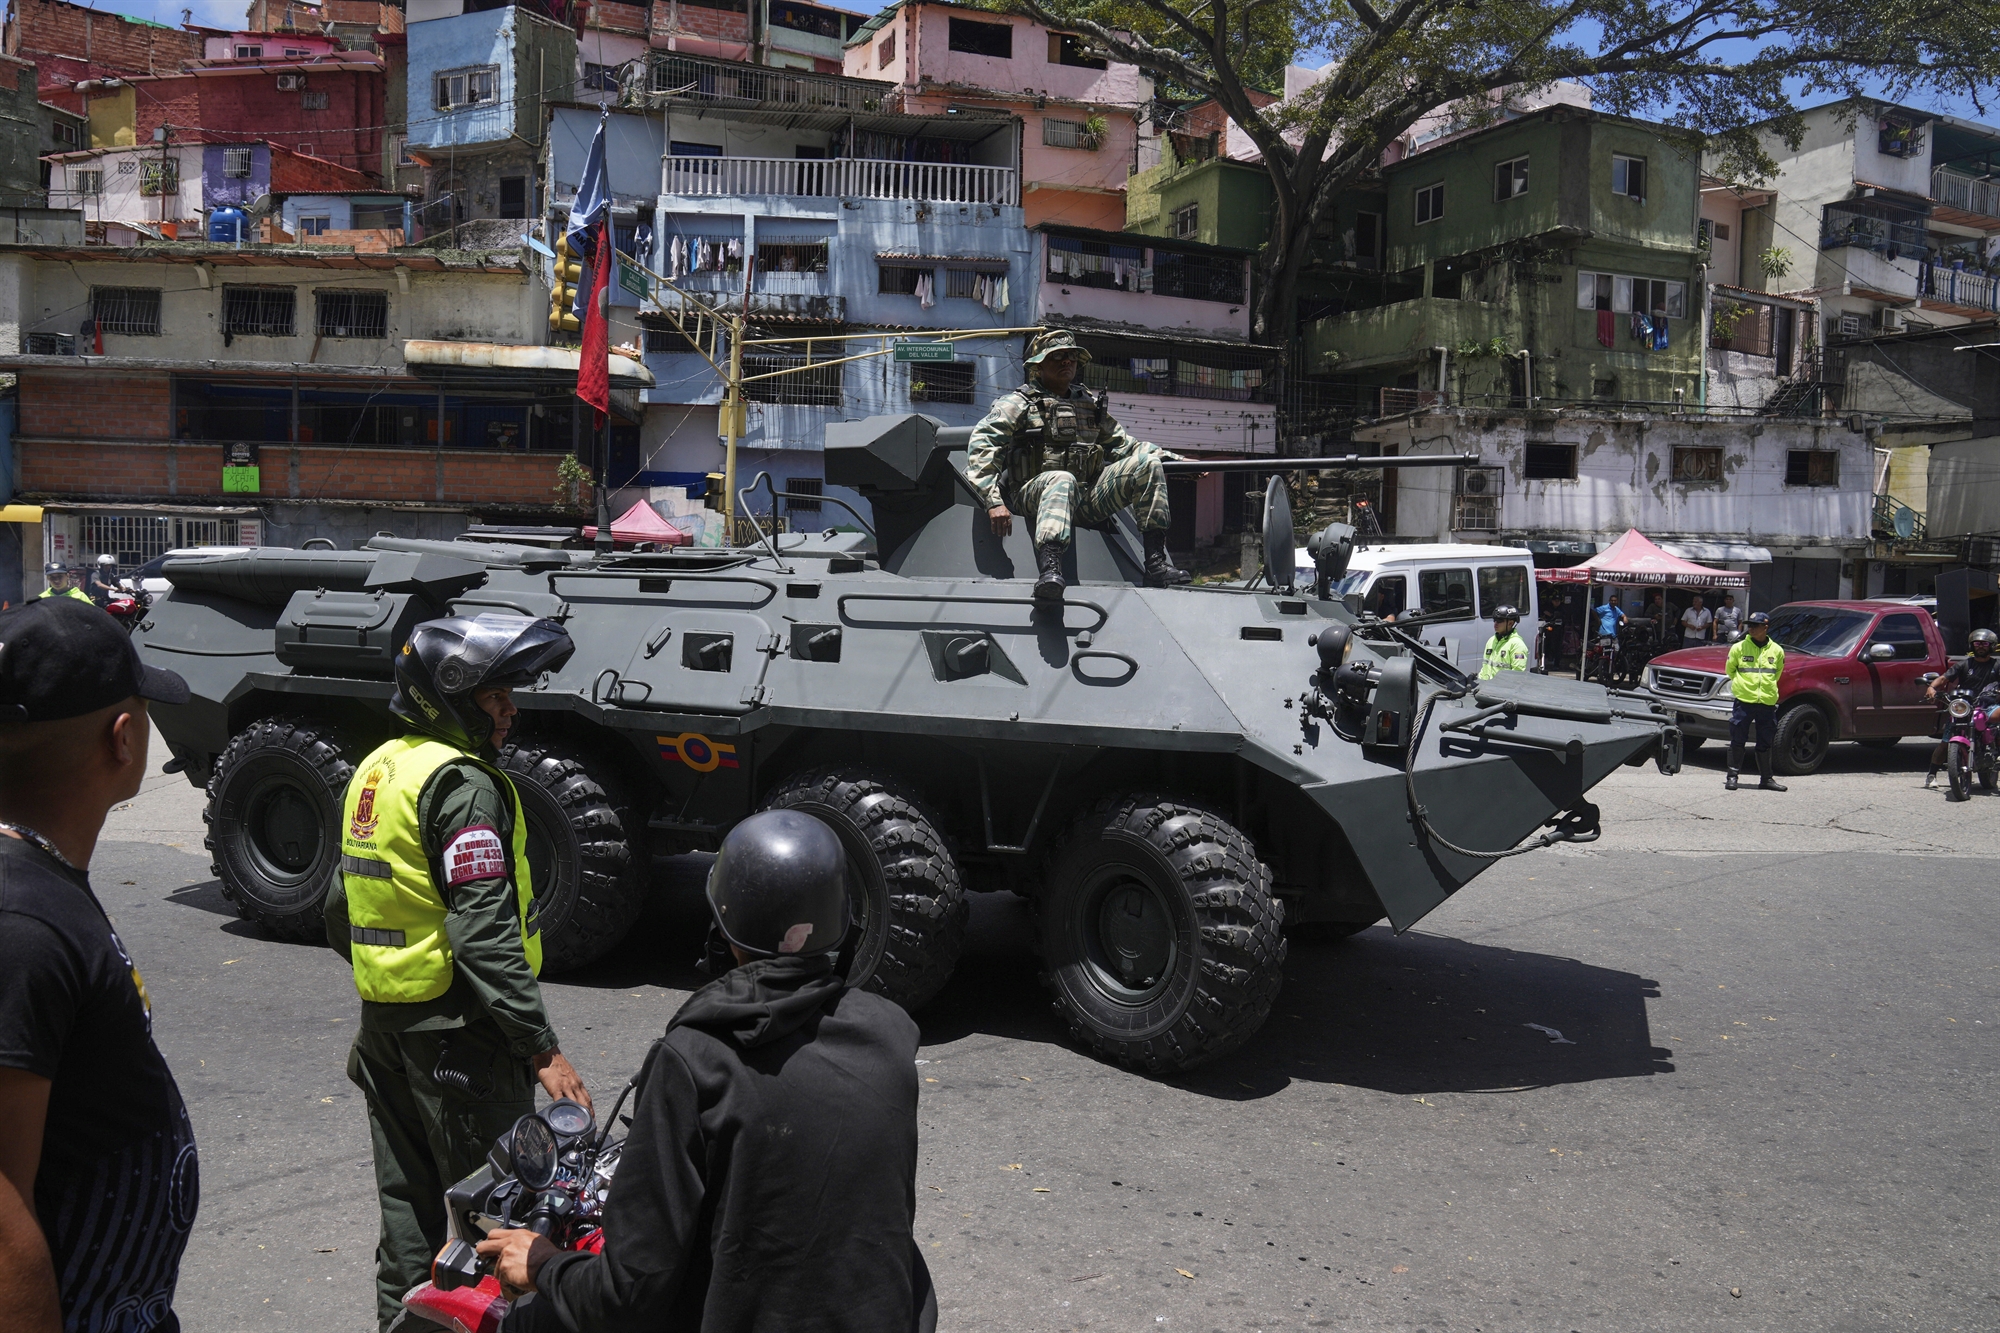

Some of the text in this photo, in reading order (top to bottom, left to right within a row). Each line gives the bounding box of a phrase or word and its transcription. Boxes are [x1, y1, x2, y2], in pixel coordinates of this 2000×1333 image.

[628, 272, 640, 284] CALLE
[233, 481, 250, 493] 16
[1595, 571, 1745, 587] MOTO71 LIANDA MOTO71 LIANDA
[409, 685, 440, 720] EDGE
[346, 838, 378, 851] BOLIVARIANA
[464, 839, 493, 851] BORGES
